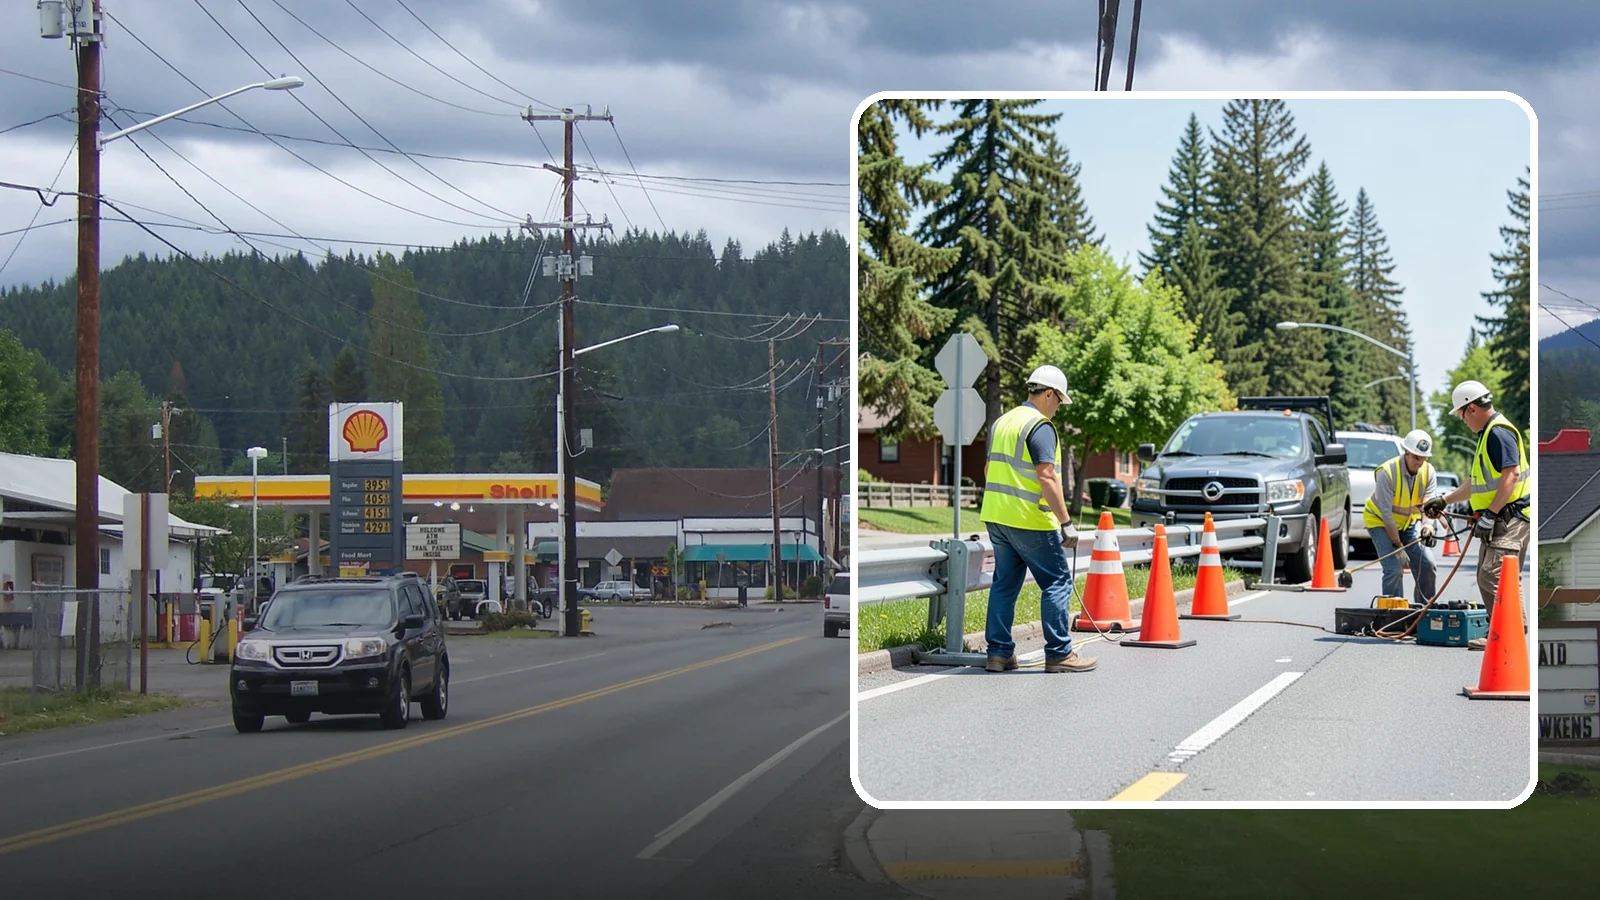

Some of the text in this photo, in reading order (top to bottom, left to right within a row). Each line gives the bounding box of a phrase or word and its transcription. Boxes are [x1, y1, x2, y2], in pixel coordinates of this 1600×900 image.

[366, 480, 383, 490] 395
[490, 484, 547, 499] Shell
[366, 494, 383, 504] 405
[366, 508, 383, 518] 415
[366, 522, 383, 532] 429
